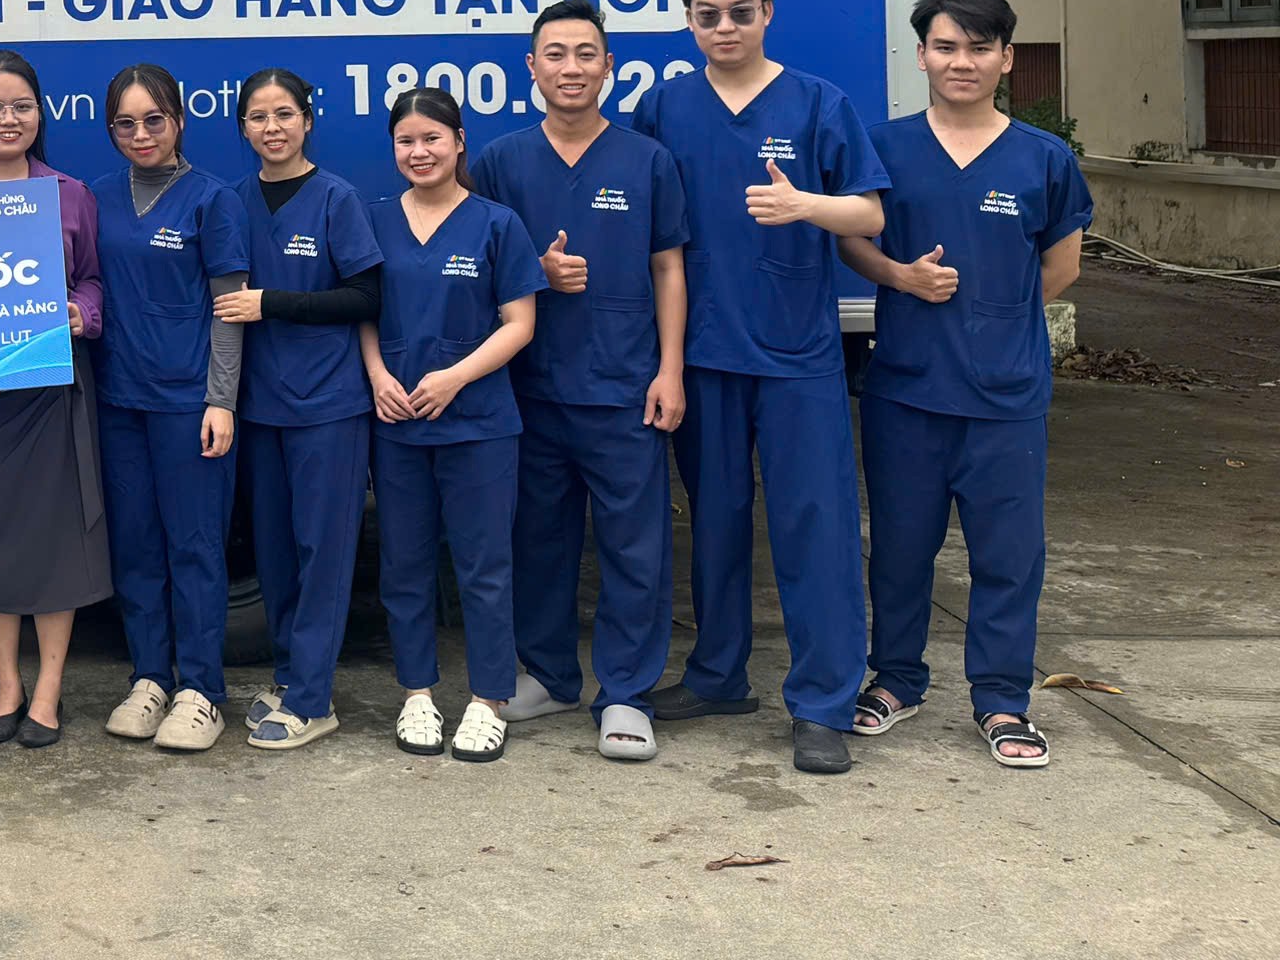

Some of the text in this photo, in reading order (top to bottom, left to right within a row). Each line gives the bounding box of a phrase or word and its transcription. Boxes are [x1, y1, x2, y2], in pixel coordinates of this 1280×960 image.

[3, 202, 37, 216] CHÂU
[13, 298, 58, 316] NẴNG
[1, 329, 32, 346] LỤT
